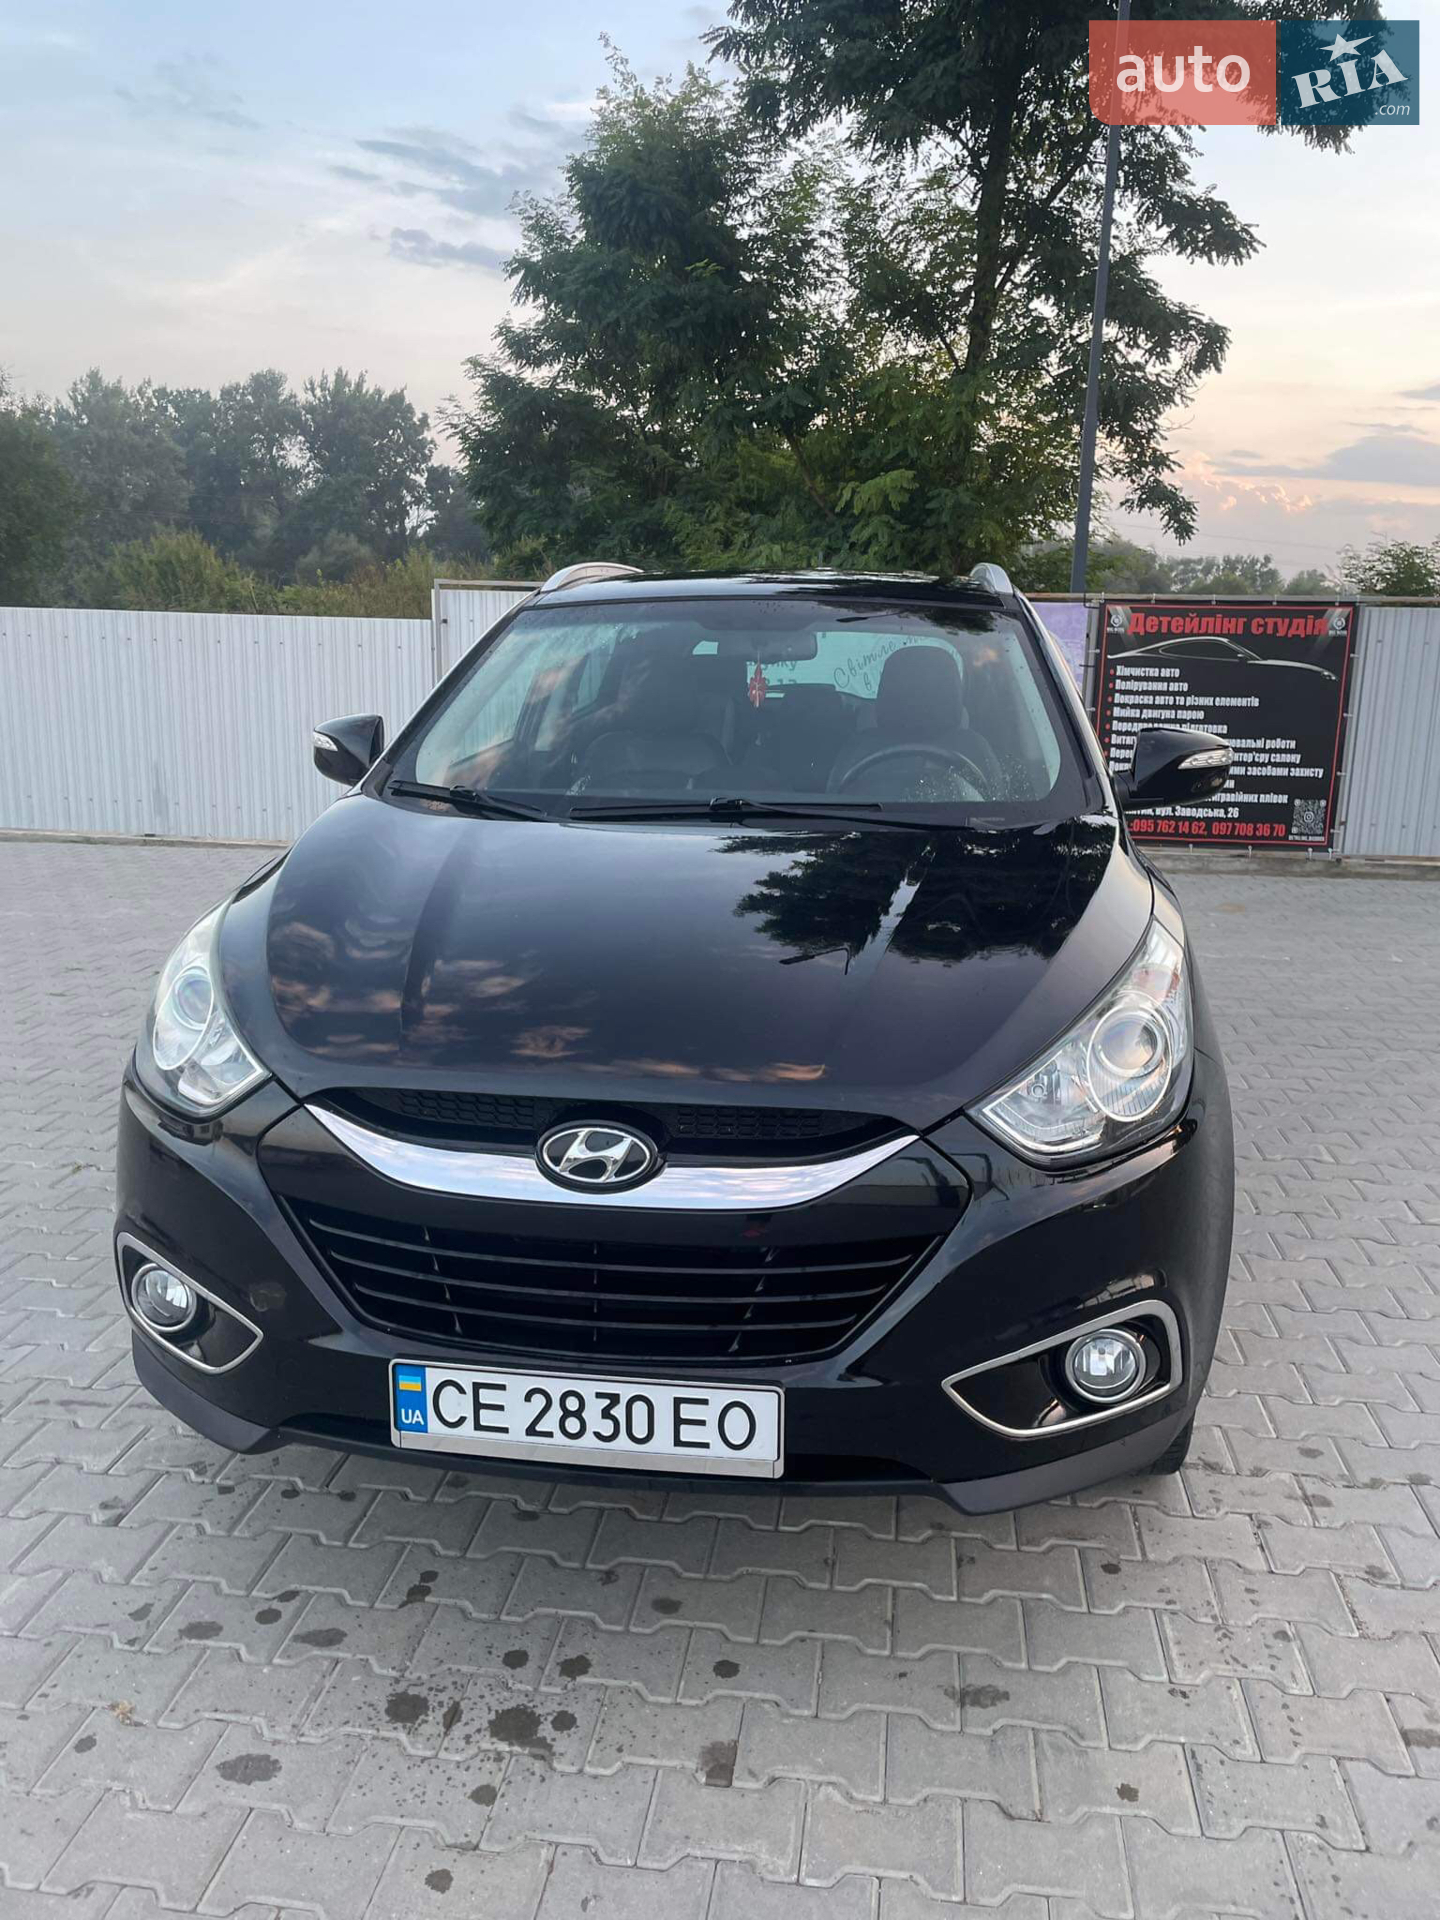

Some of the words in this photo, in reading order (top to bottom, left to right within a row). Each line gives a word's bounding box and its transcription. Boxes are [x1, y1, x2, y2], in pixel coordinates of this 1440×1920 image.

[1127, 612, 1247, 636] Детейлінг
[1250, 615, 1329, 638] студія
[1116, 665, 1159, 677] Хімчистка
[1160, 668, 1180, 678] авто
[1115, 679, 1168, 692] Полірування
[1169, 682, 1189, 692] авто
[1114, 693, 1154, 705] Покраска
[1155, 696, 1174, 705] авто
[1176, 696, 1185, 705] та
[1186, 695, 1214, 707] різних
[1215, 696, 1260, 707] елементів
[1113, 707, 1140, 718] Мийка
[1141, 708, 1175, 719] двигуна
[1177, 710, 1205, 720] парою
[1265, 738, 1296, 749] роботи
[1233, 751, 1270, 763] нтер'єру
[1270, 753, 1301, 764] салону
[1247, 765, 1289, 776] засобами
[1289, 767, 1324, 779] захисту
[1259, 792, 1288, 803] плівок
[1156, 806, 1174, 817] вул.
[1175, 806, 1226, 818] Заводська,
[1227, 807, 1239, 818] 26
[1156, 820, 1176, 833] 762
[1178, 821, 1190, 834] 14
[1191, 821, 1207, 835] 62,
[1212, 822, 1234, 835] 097
[1234, 823, 1253, 836] 708
[1256, 824, 1270, 836] 36
[1273, 824, 1286, 836] 70
[401, 1408, 425, 1426] UA
[432, 1378, 509, 1434] CE
[523, 1387, 655, 1445] 2830
[673, 1396, 757, 1451] EO
